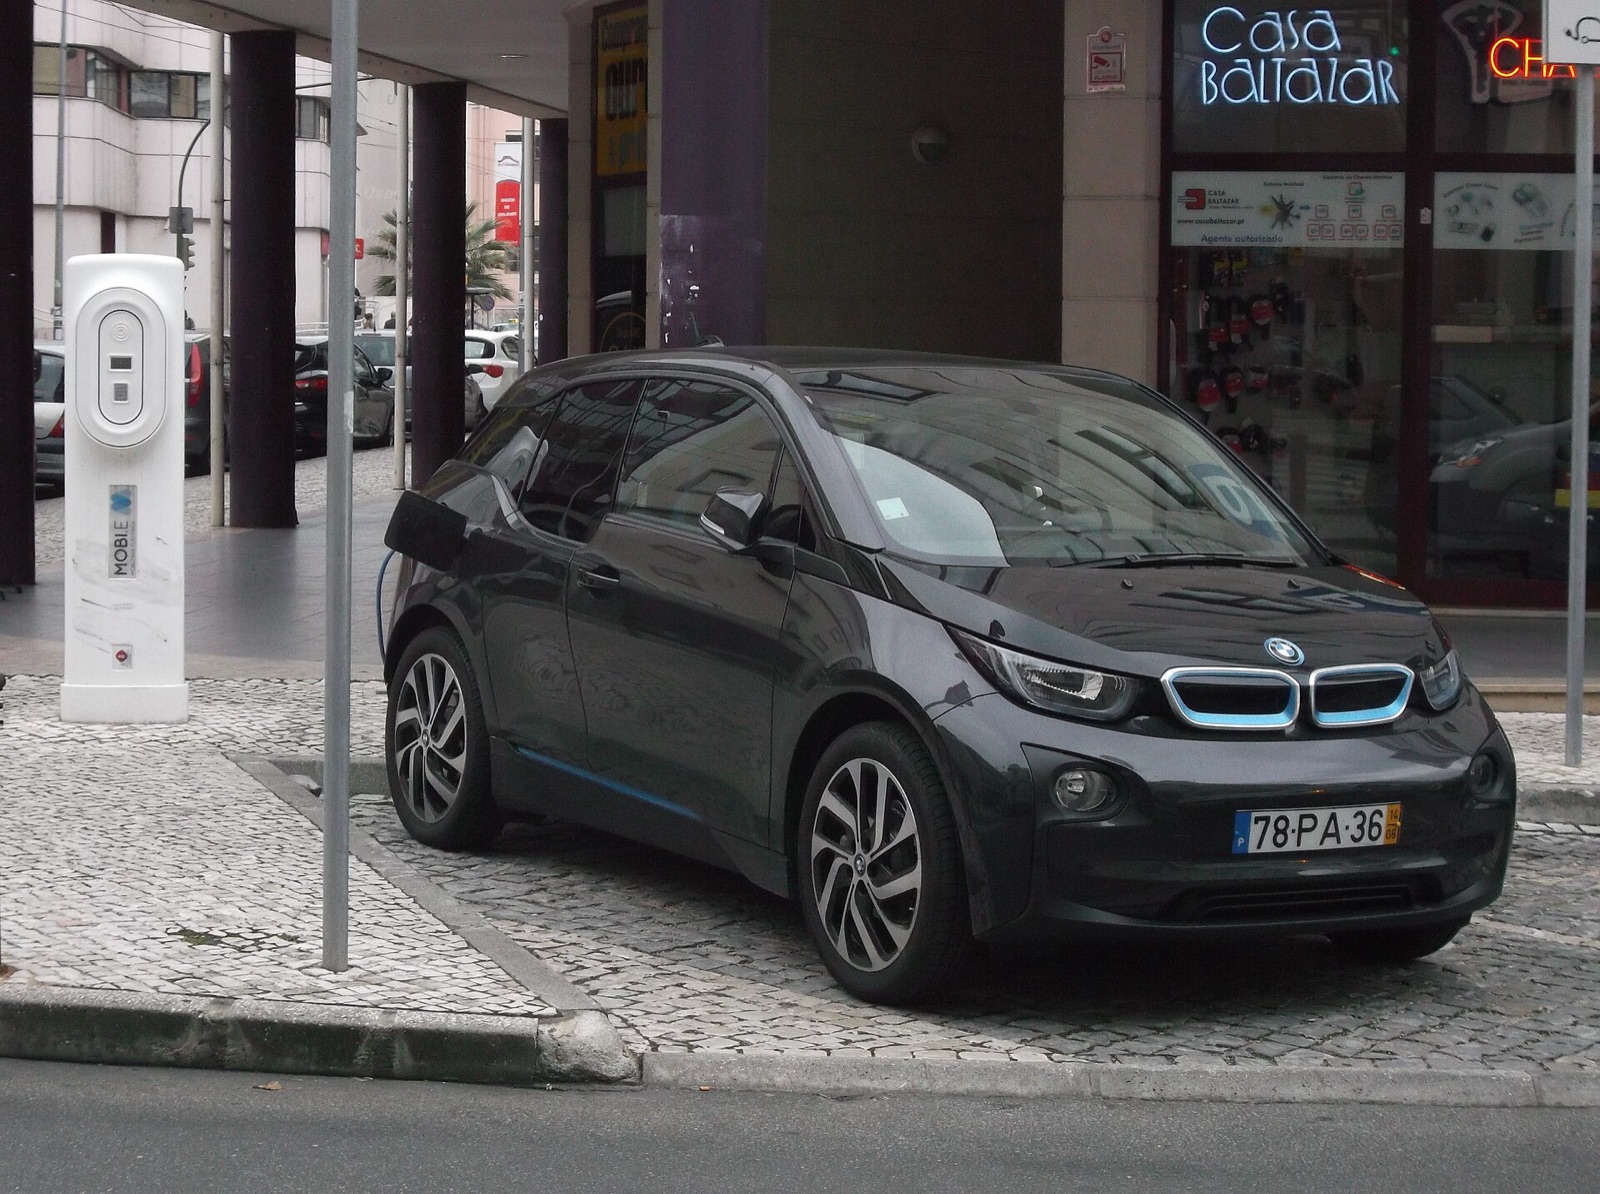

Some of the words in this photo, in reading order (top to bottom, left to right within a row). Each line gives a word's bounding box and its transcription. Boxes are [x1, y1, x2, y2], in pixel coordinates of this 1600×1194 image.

[1201, 234, 1232, 245] Agente
[1235, 234, 1284, 243] autorizado
[1390, 809, 1399, 821] 14
[1237, 837, 1245, 847] P
